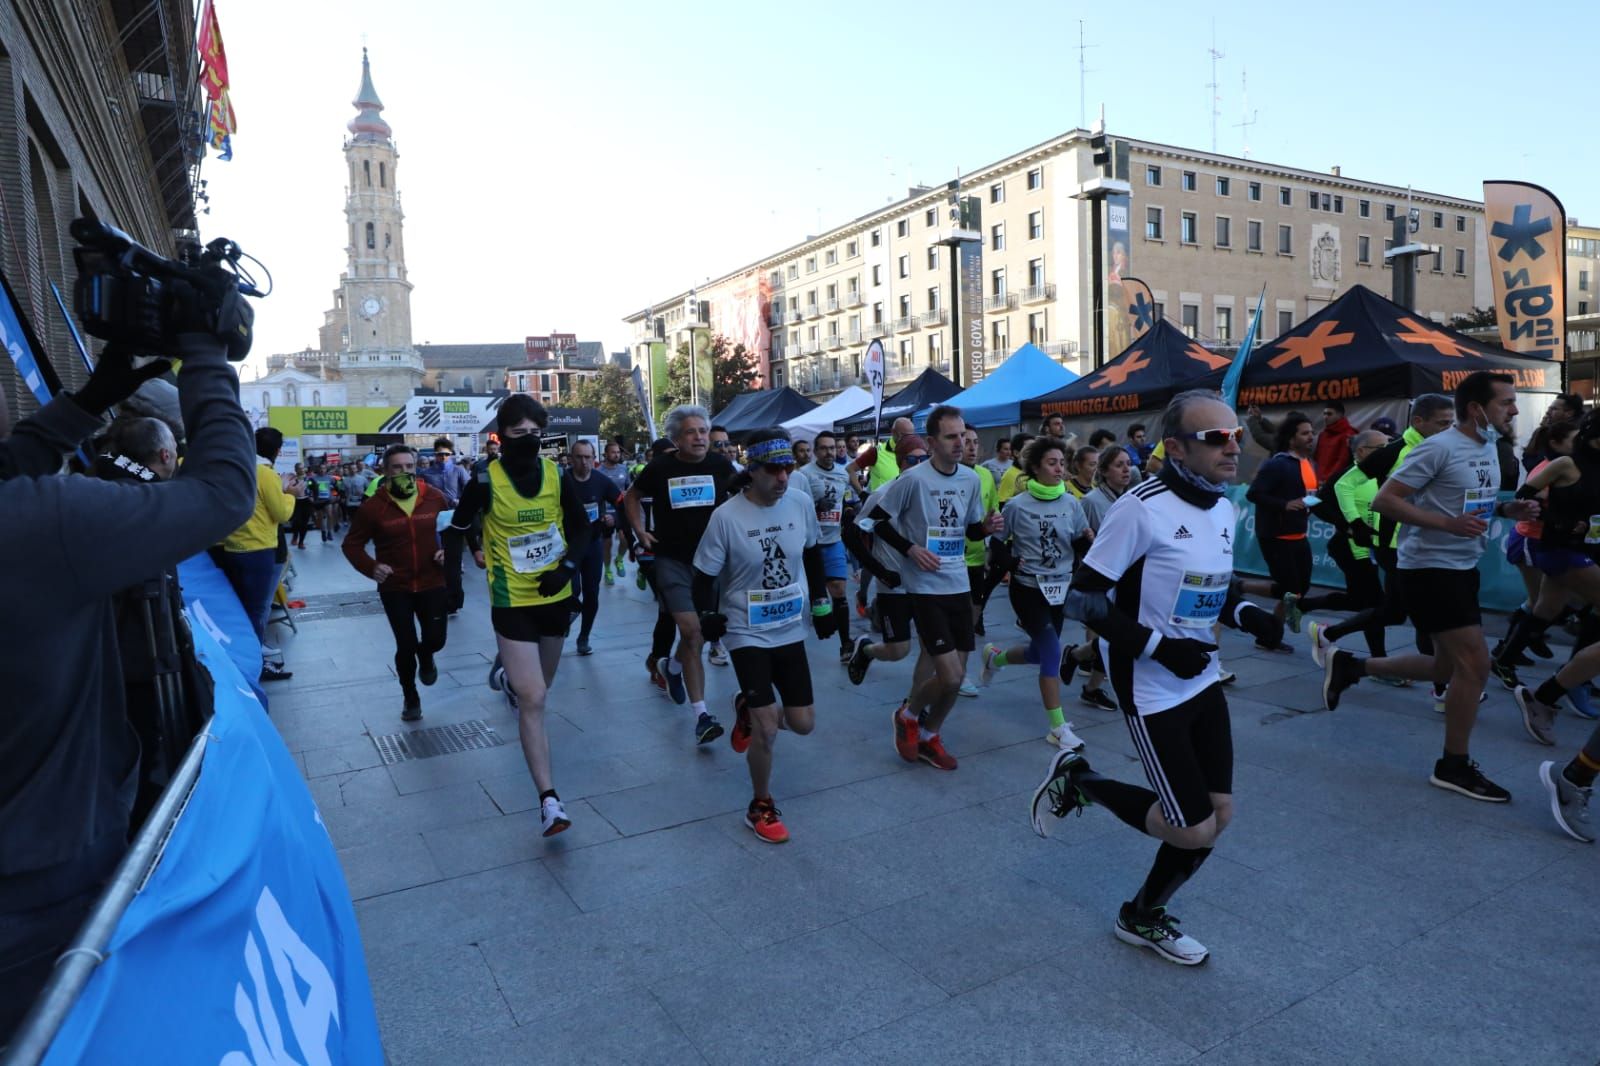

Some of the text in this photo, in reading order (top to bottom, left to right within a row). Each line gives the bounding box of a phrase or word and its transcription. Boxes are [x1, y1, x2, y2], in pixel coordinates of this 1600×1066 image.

[970, 319, 982, 347] GOYA
[1238, 377, 1360, 406] NINGZGZ.COM
[1041, 393, 1139, 416] RUNNINGZGZ.COM
[304, 412, 345, 420] MANN
[549, 415, 582, 424] CaixaBank
[304, 420, 345, 428] FILTER
[680, 487, 704, 497] 3197
[759, 536, 778, 548] 10K
[938, 541, 960, 551] 3201
[761, 602, 793, 617] 3402
